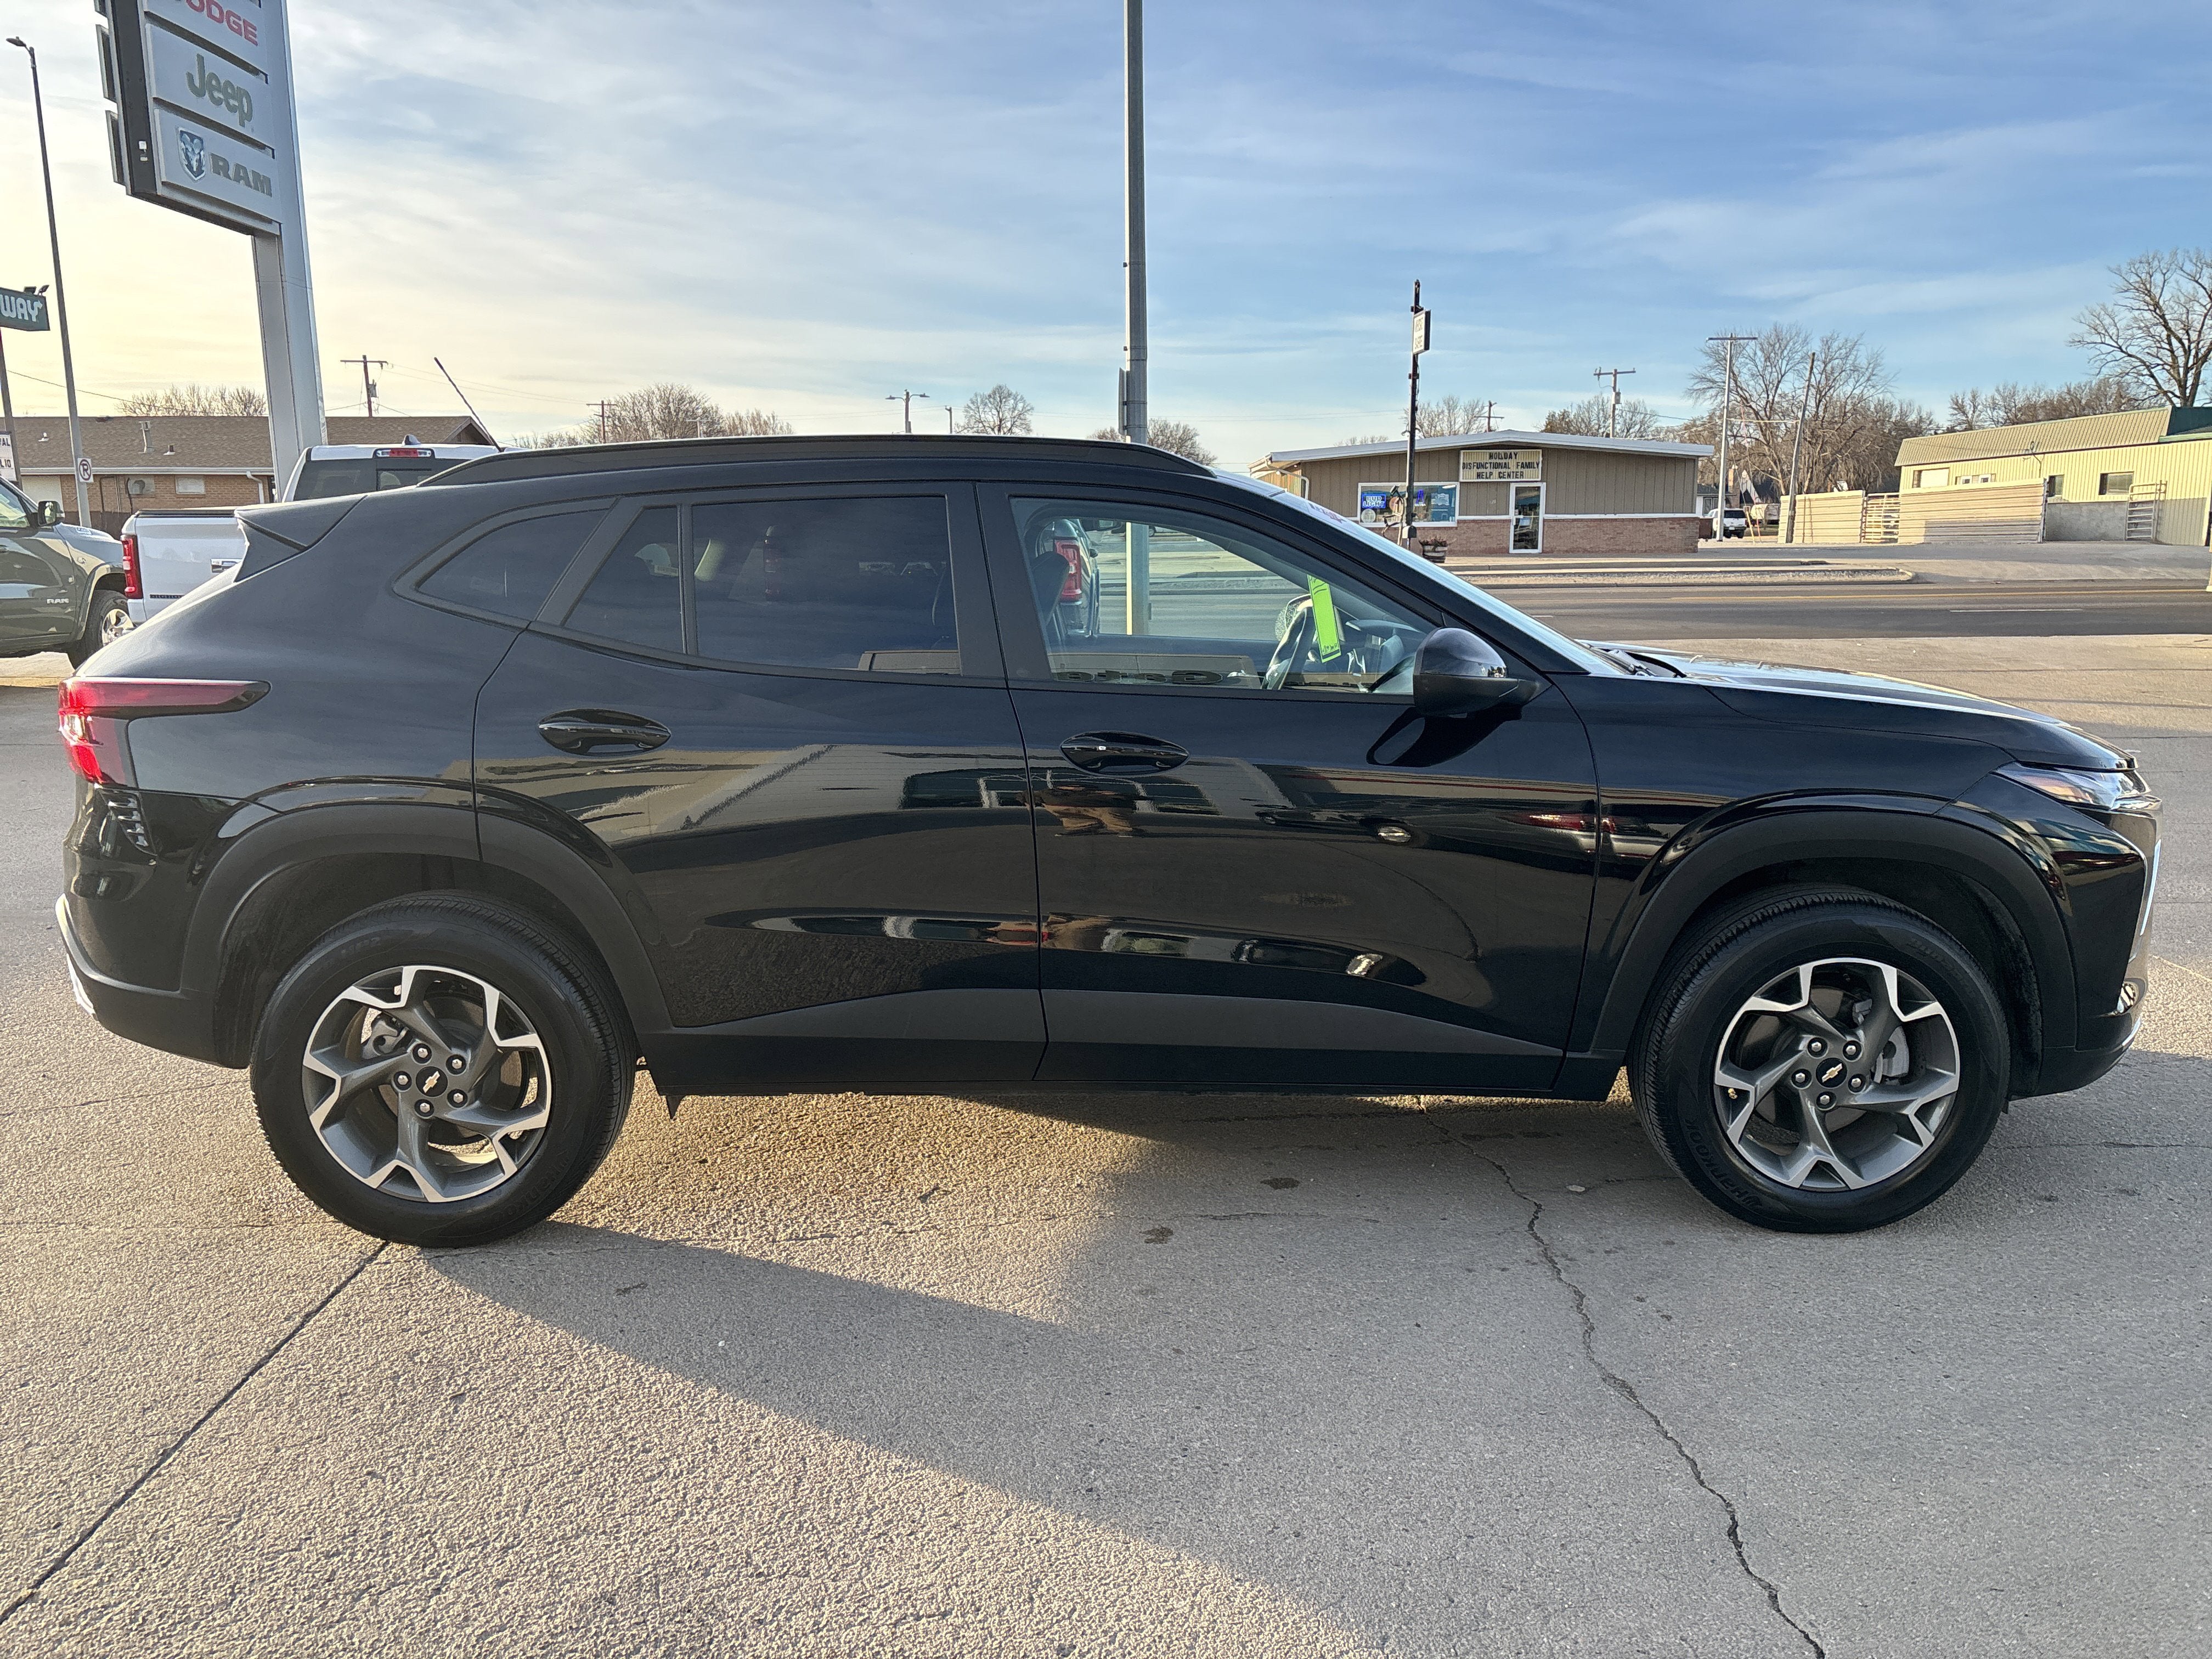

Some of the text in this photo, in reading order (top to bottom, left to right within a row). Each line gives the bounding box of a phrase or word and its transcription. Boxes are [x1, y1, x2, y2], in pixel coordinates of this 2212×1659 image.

[185, 0, 258, 47] ODGE
[186, 54, 253, 128] Jeep
[211, 153, 273, 198] RAM
[1462, 461, 1510, 470] DISFUNCTIONAL
[1498, 471, 1524, 479] CENTER
